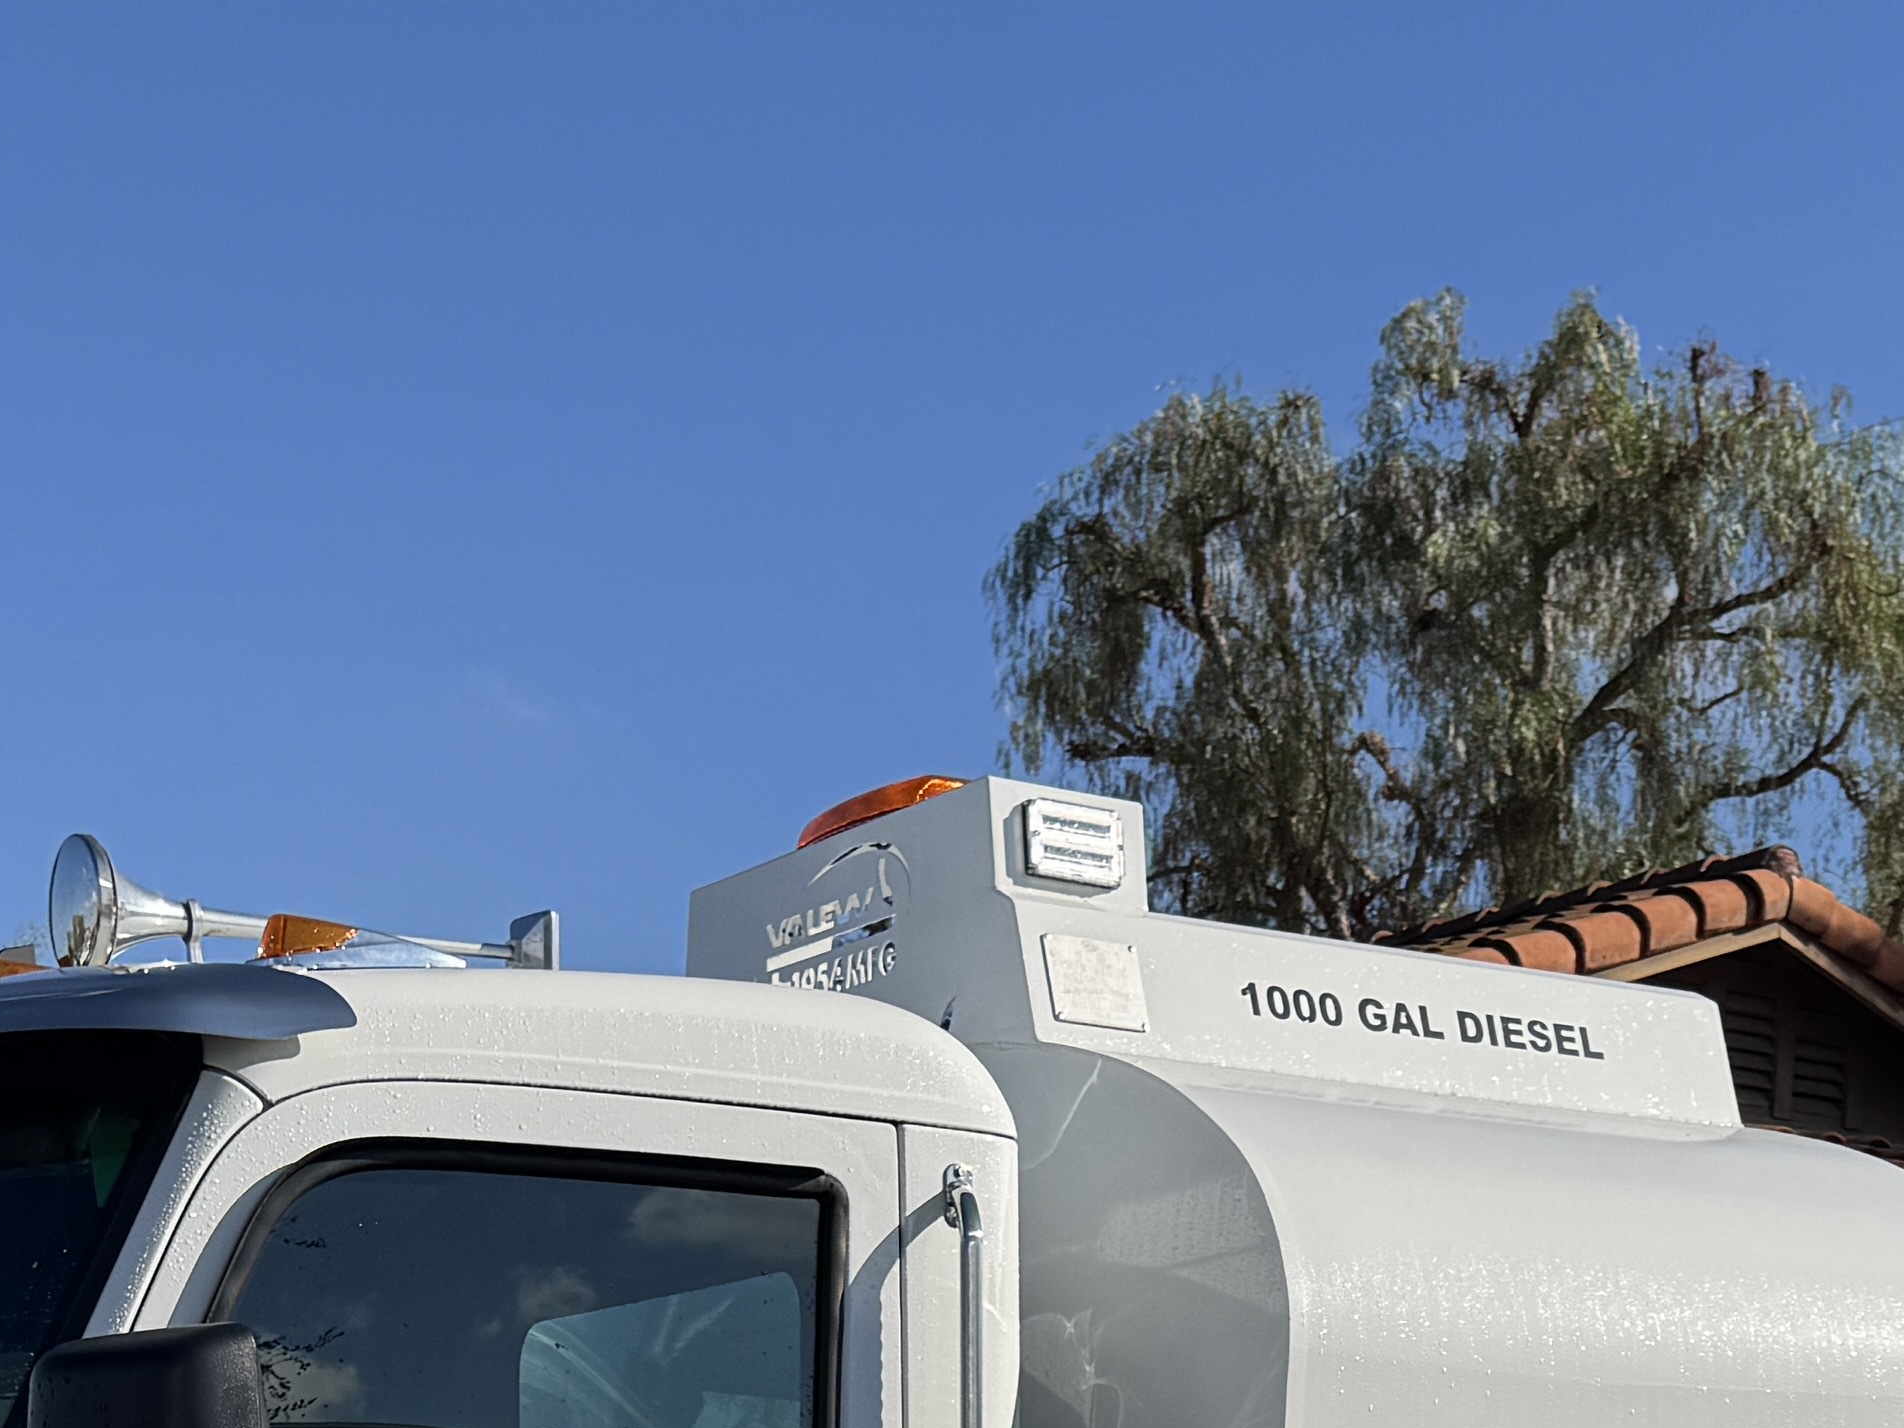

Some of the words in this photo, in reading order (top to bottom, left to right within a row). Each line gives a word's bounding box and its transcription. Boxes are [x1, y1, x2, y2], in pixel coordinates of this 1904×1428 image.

[1240, 981, 1343, 1027] 1000
[1357, 997, 1445, 1040] GAL
[1456, 1009, 1606, 1060] DIESEL
